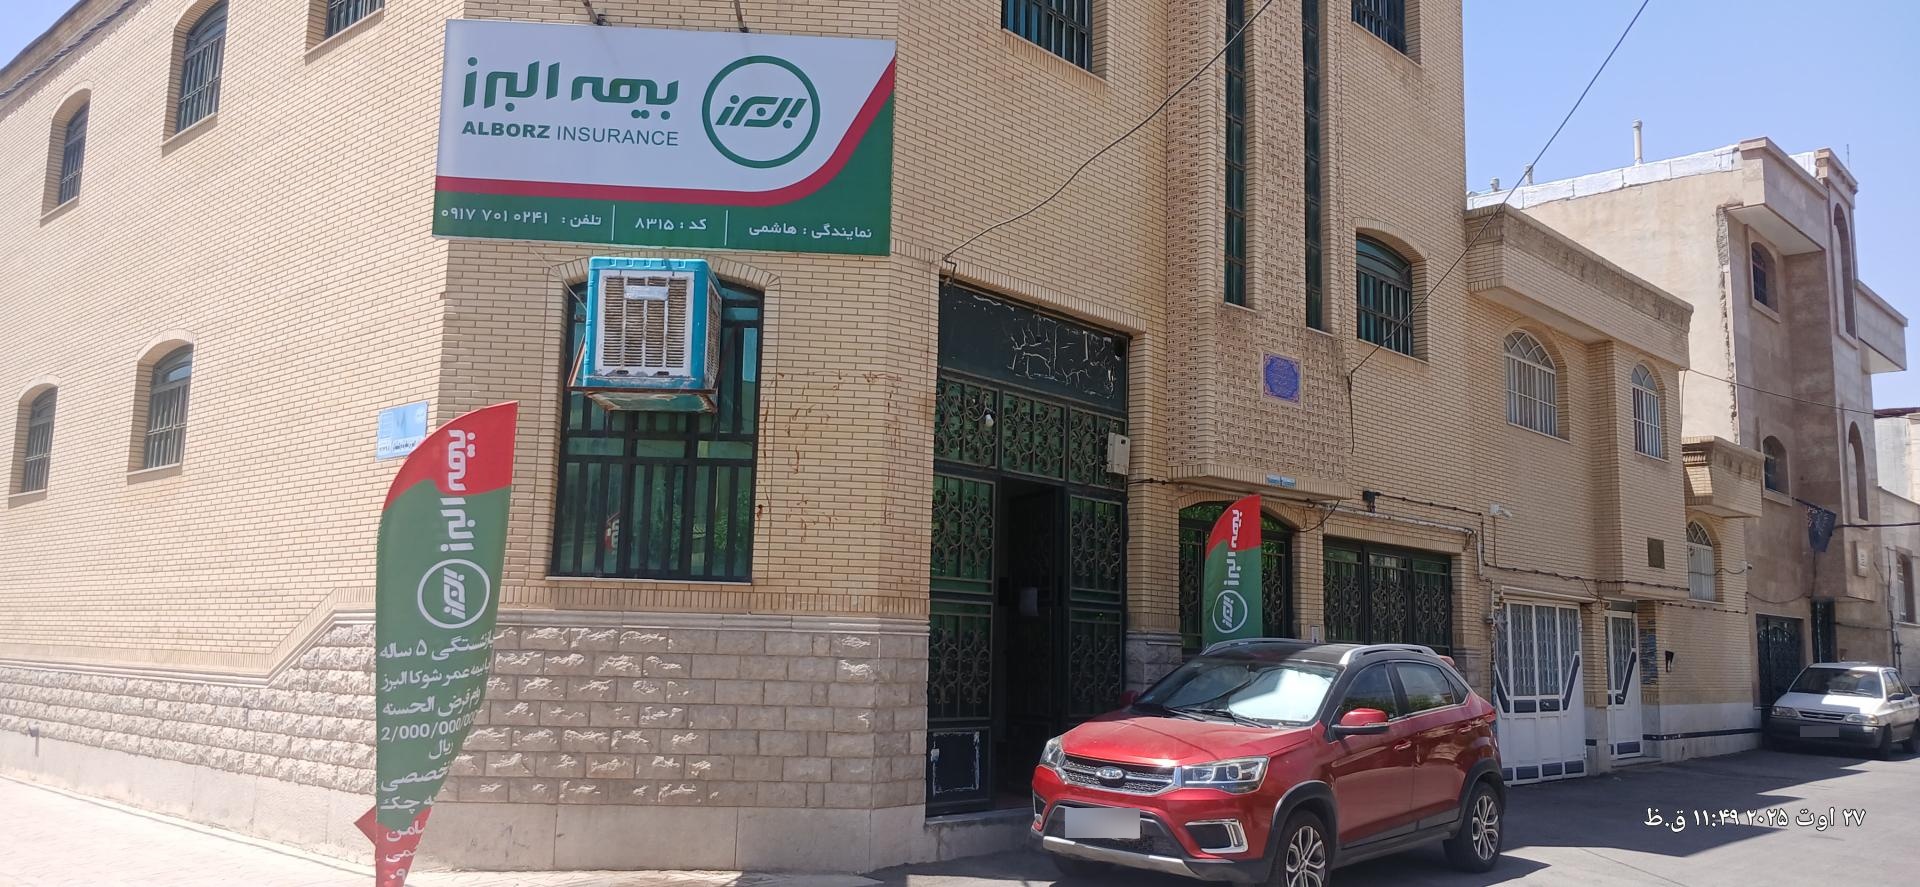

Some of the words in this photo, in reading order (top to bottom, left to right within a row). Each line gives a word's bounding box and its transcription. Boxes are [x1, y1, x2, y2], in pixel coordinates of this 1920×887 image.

[463, 56, 560, 112] البرز
[570, 75, 680, 121] بیمه
[461, 121, 551, 139] ALBORZ
[557, 125, 680, 147] INSURANCE
[441, 207, 476, 221] ۰۹۱۷
[482, 209, 508, 222] ۷۰۱
[513, 211, 548, 225] ۰۲۴۱
[569, 214, 602, 226] تلفن
[634, 217, 675, 230] ۸۳۱۵
[689, 218, 707, 230] کد
[749, 222, 797, 236] هاشمی
[811, 223, 873, 240] نمایندگی
[448, 429, 476, 491] بیمه
[440, 497, 475, 551] البرز
[379, 641, 413, 659] ساله
[415, 639, 428, 656] ۵
[380, 670, 408, 693] البرز
[441, 667, 470, 687] عمر
[382, 695, 436, 716] الحسنه
[380, 796, 421, 815] چک
